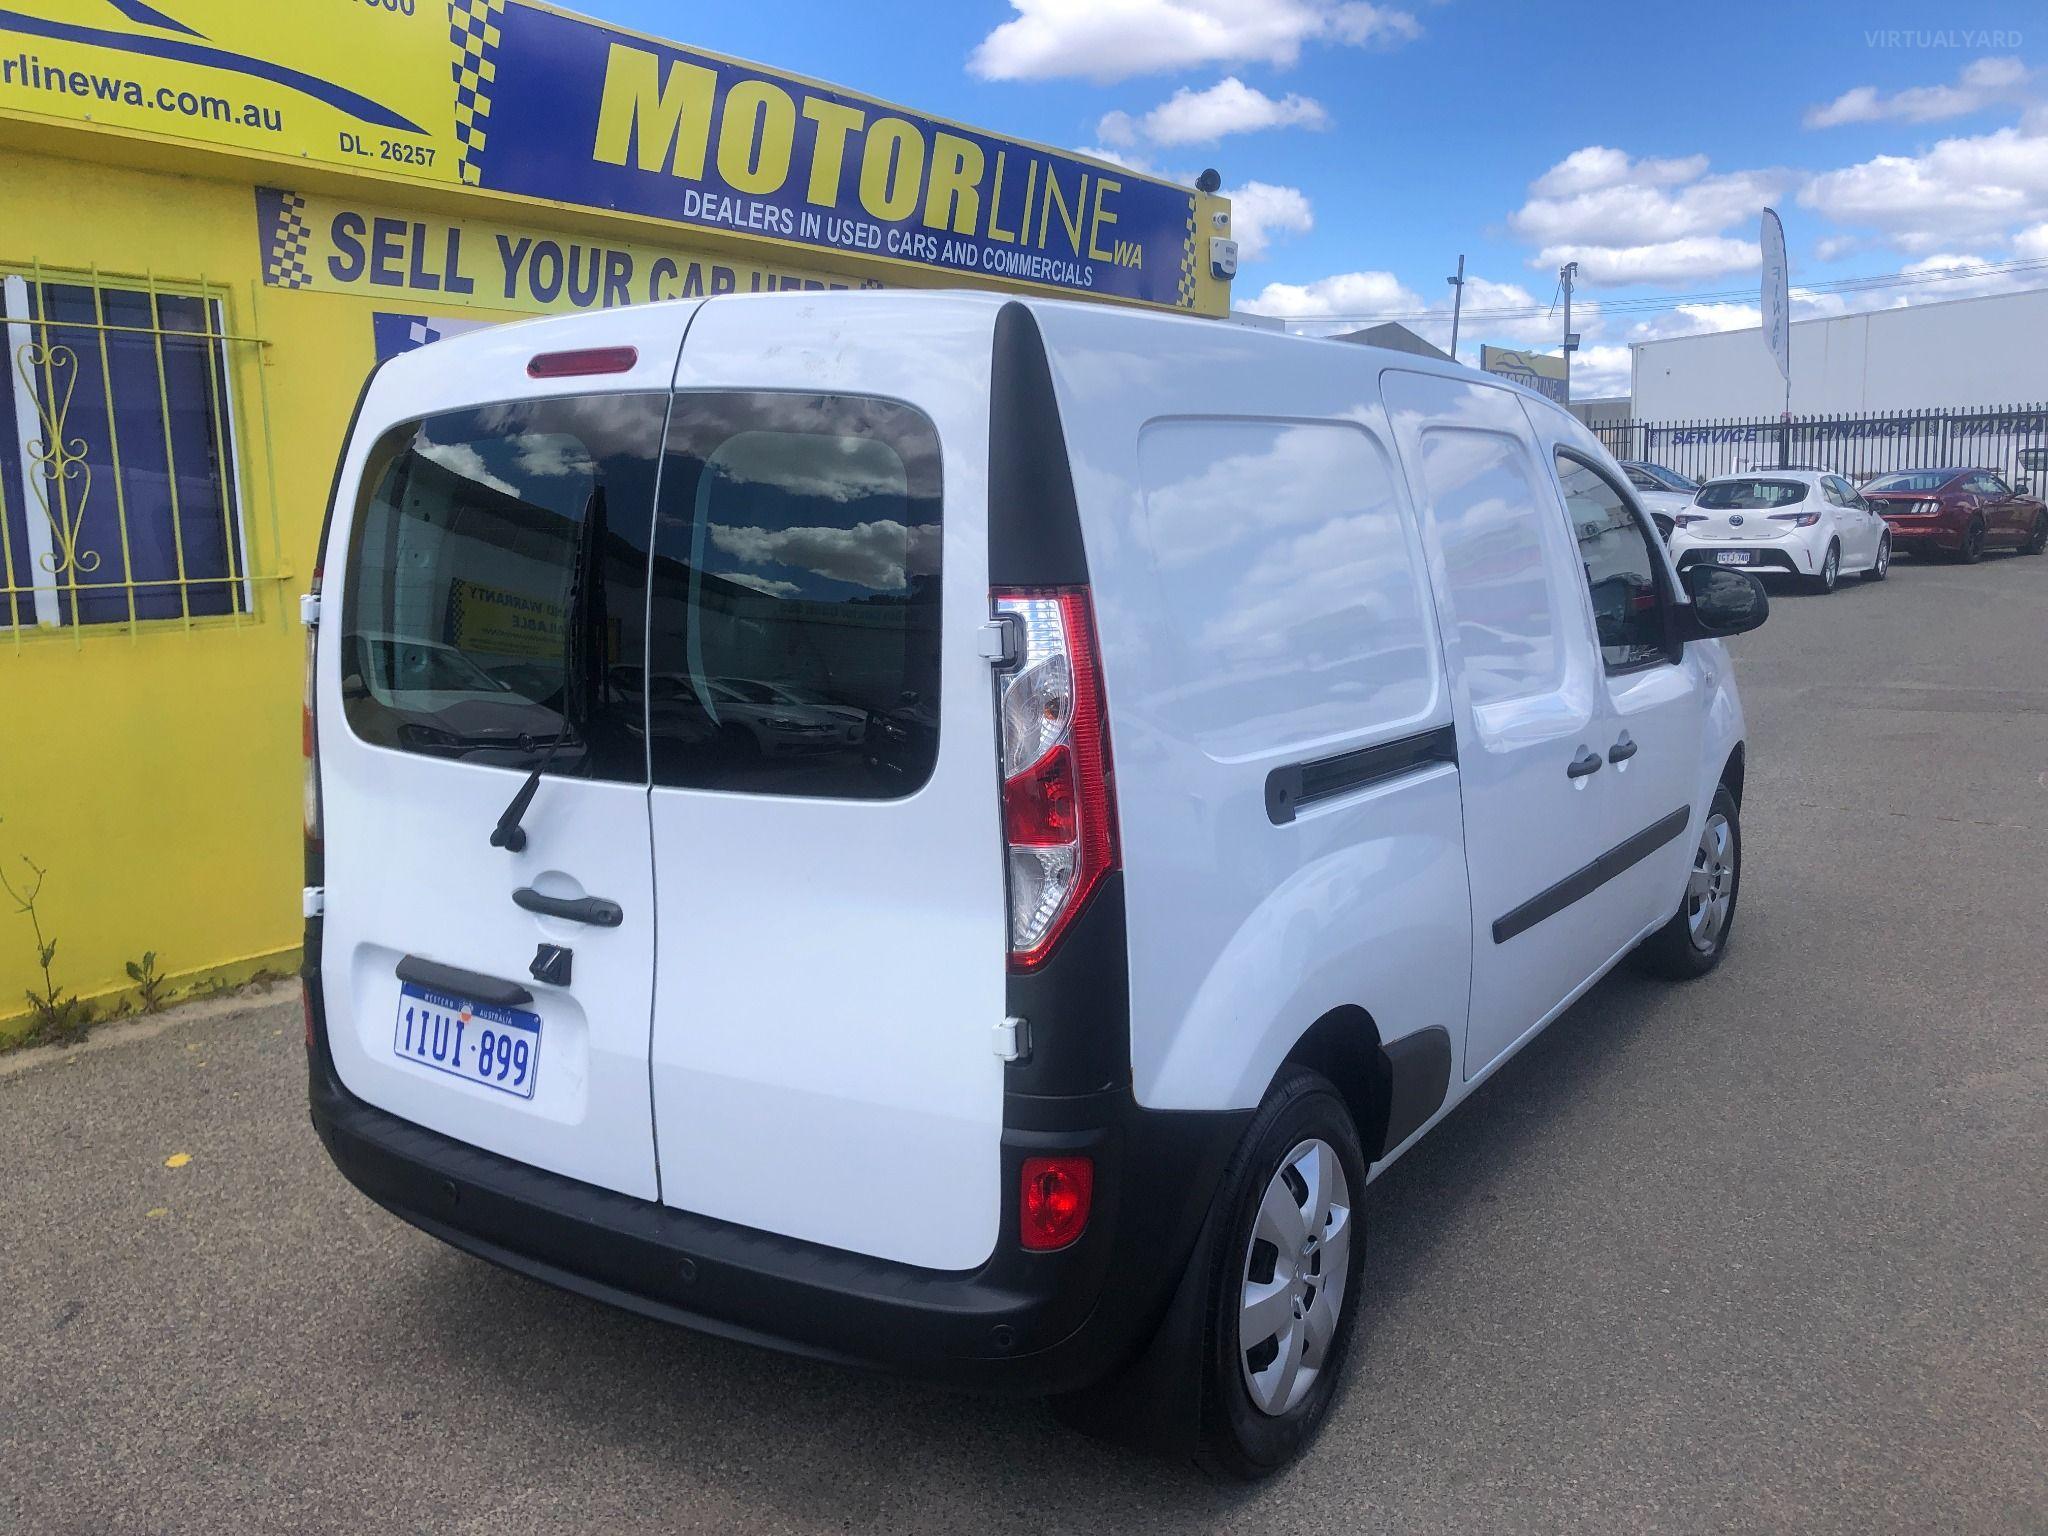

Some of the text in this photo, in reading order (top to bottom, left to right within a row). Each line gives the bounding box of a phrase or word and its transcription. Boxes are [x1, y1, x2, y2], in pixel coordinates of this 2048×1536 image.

[2, 54, 283, 132] rlinewa.com.au
[338, 131, 437, 168] DL. 26257
[683, 189, 1094, 287] DEALERS IN USED CARS AND COMMERCIALS
[1113, 239, 1144, 270] WA
[327, 210, 475, 295] SELL
[495, 233, 634, 308] YOUR
[1671, 427, 1757, 445] SERVICE
[479, 1009, 513, 1025] AUSTRALIA
